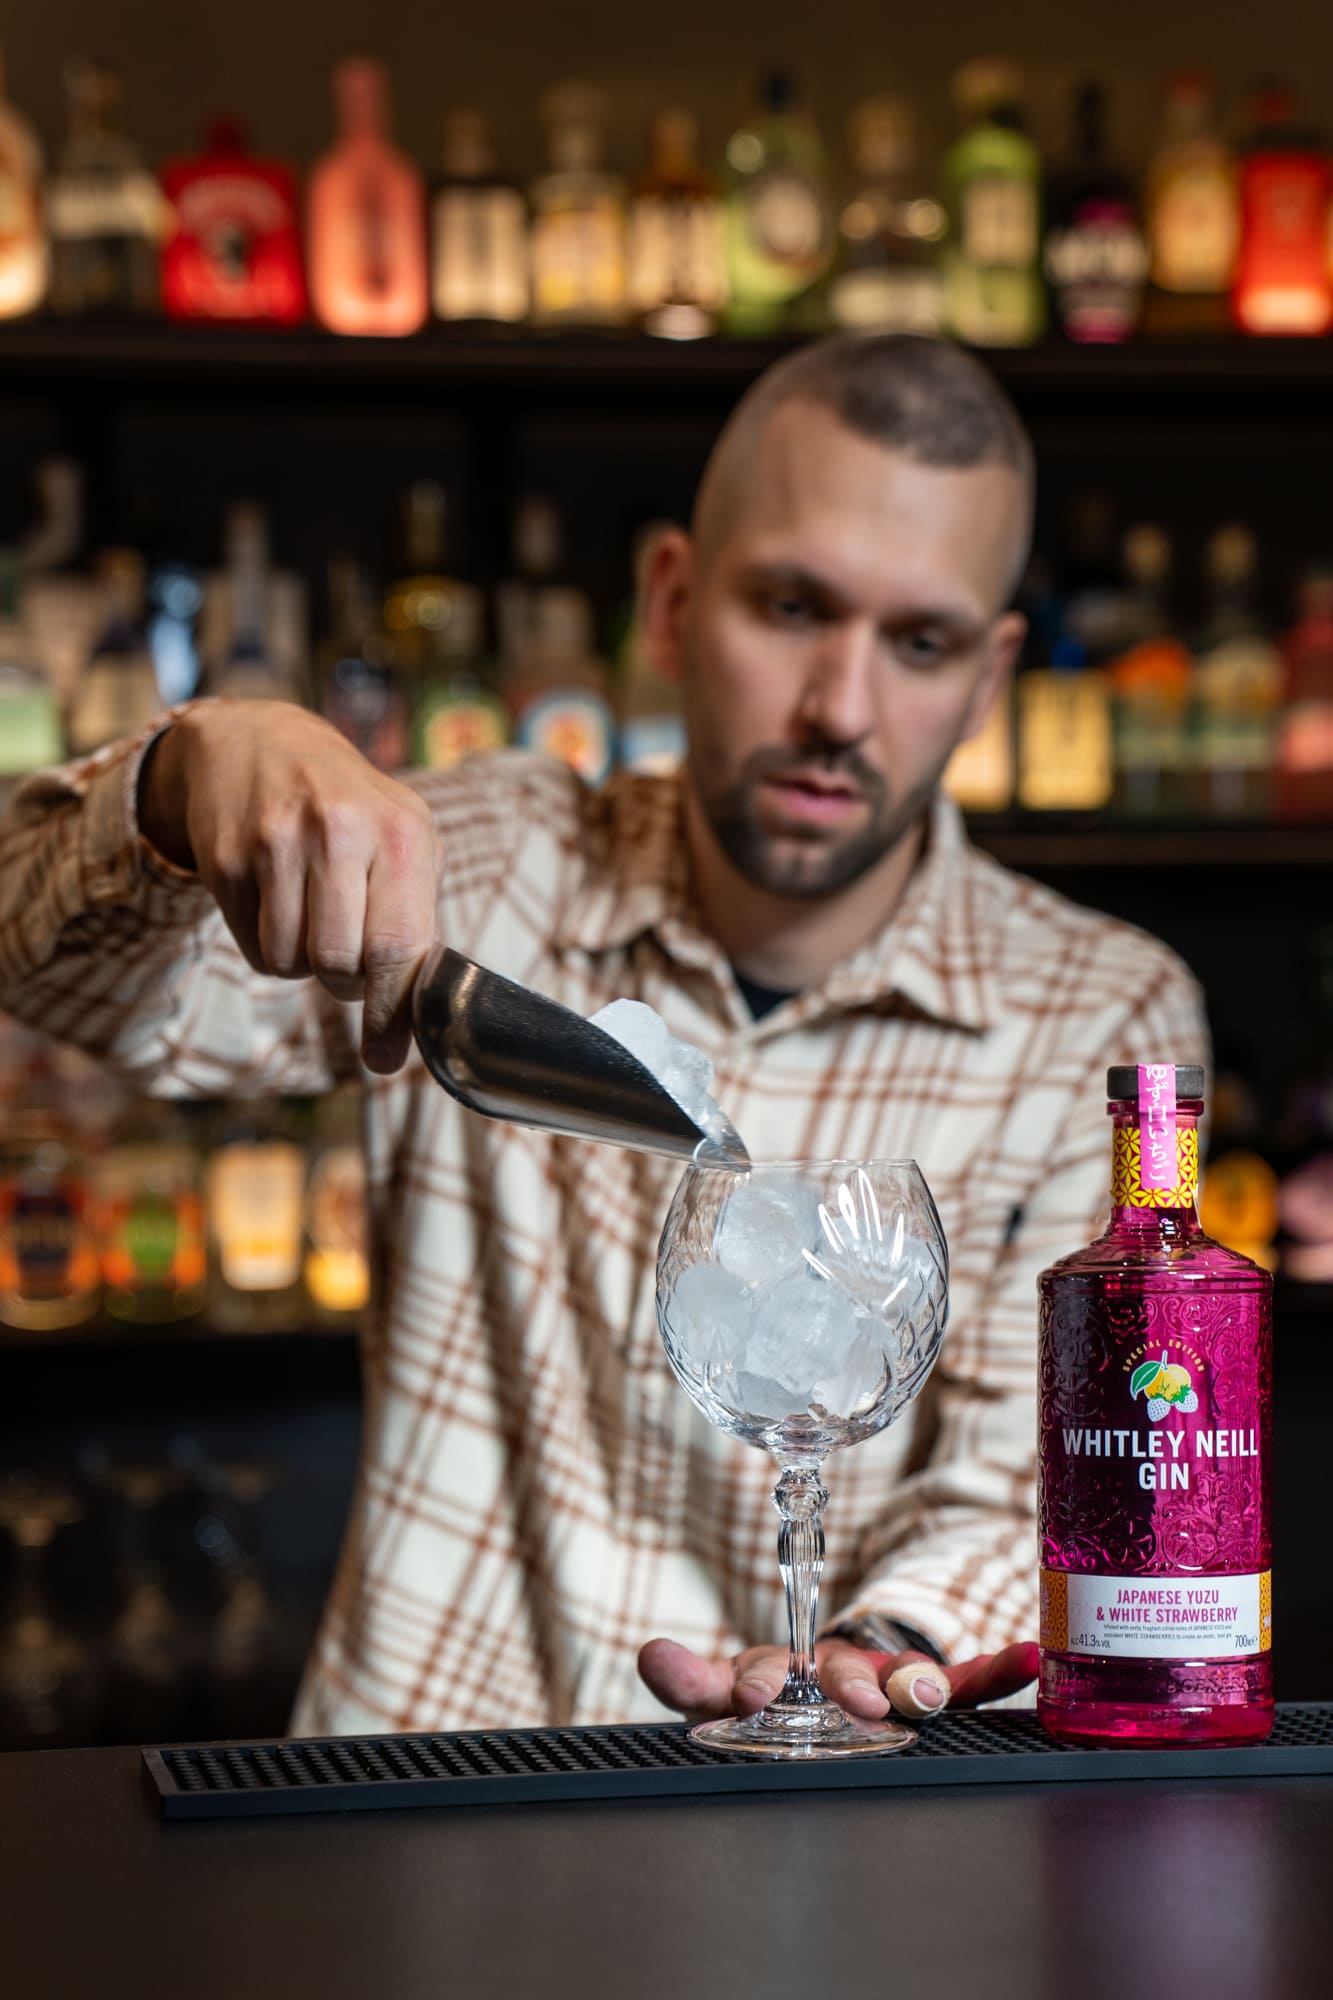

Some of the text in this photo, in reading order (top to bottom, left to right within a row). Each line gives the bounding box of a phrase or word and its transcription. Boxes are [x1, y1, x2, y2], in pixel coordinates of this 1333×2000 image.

[1122, 1339, 1205, 1372] SPECIAL EDITION
[1062, 1429, 1258, 1458] WHITLEY NEILL
[1139, 1462, 1189, 1490] GIN
[1117, 1589, 1219, 1605] JAPANESE YUZU
[1096, 1607, 1105, 1621] &
[1109, 1607, 1151, 1623] WHITE
[1156, 1606, 1238, 1624] STRAWBERRY
